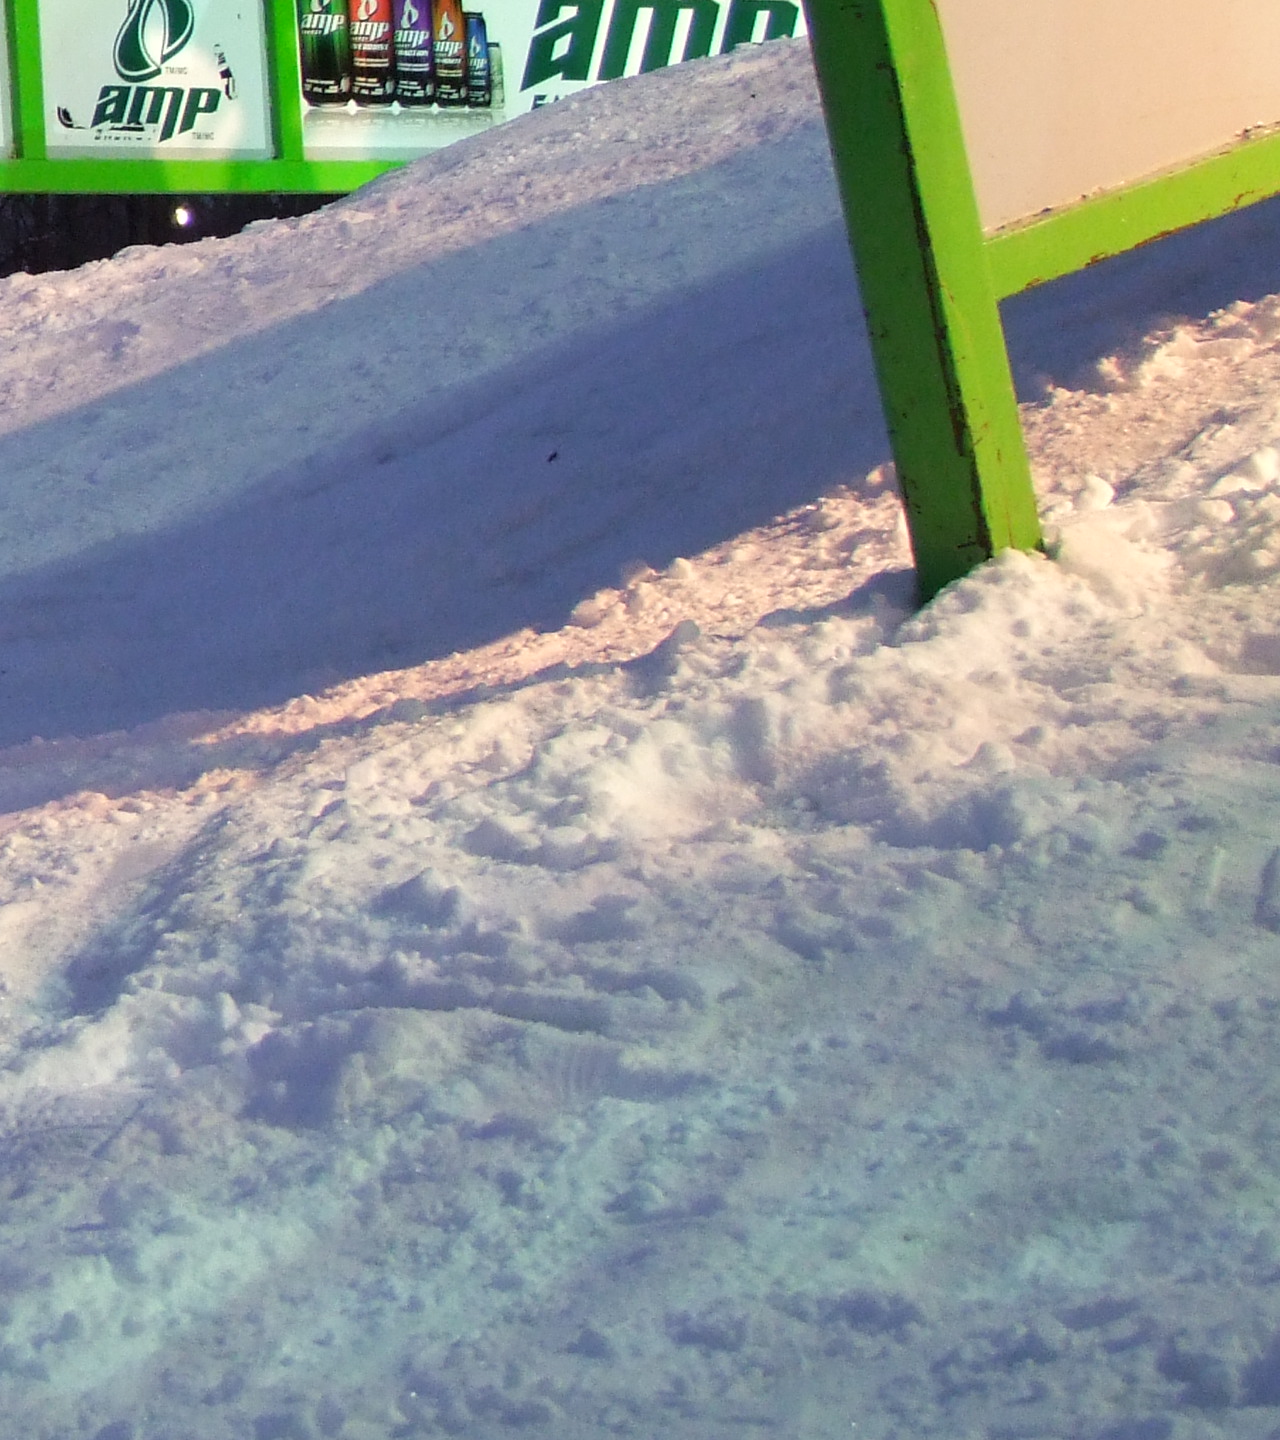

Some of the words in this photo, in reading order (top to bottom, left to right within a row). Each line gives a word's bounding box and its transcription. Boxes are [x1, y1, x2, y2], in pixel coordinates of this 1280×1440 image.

[301, 13, 346, 36] amp
[350, 21, 390, 42] amp
[394, 30, 429, 48] amp
[90, 85, 221, 143] amp
